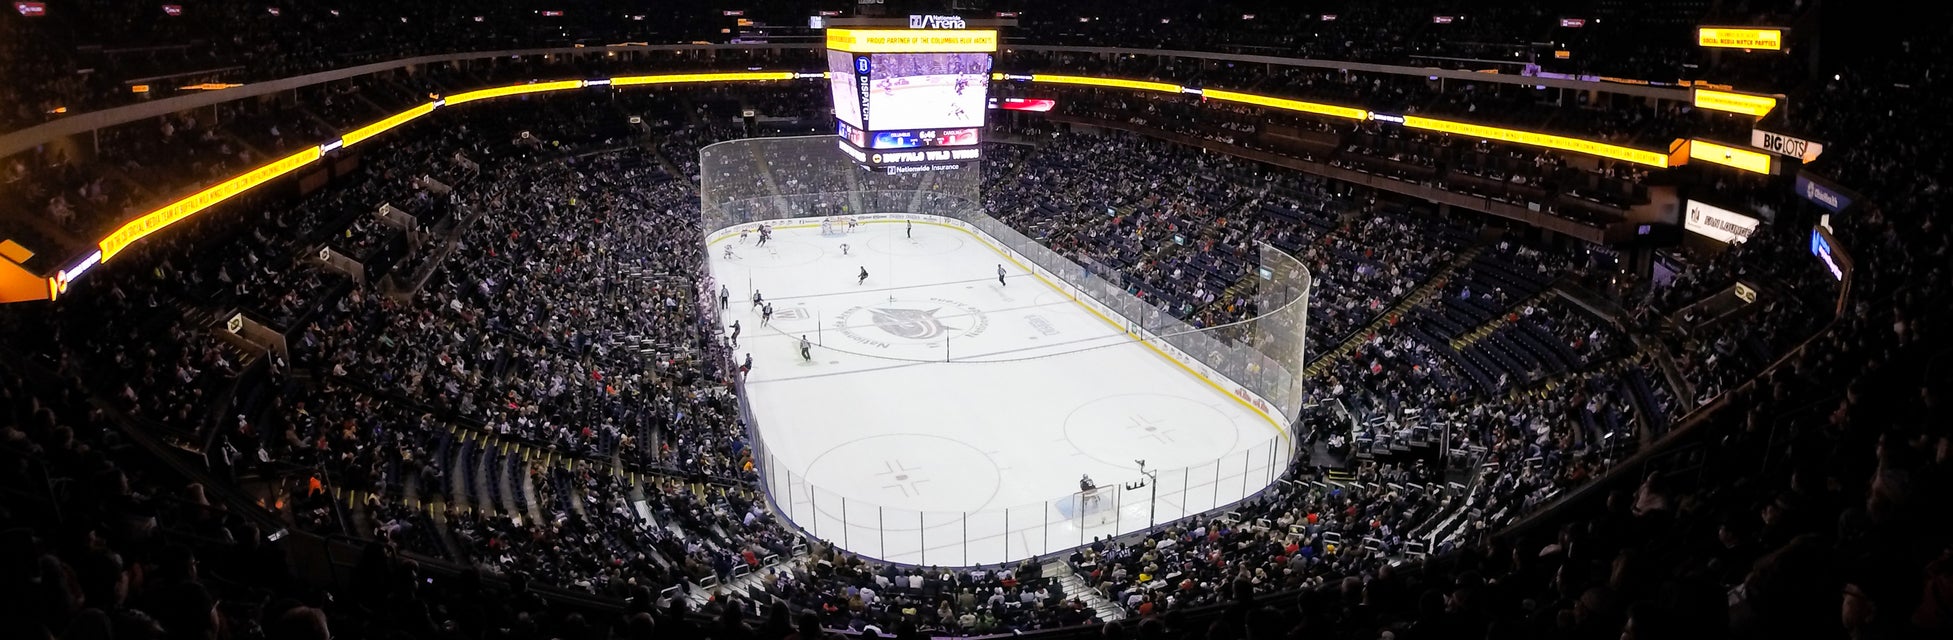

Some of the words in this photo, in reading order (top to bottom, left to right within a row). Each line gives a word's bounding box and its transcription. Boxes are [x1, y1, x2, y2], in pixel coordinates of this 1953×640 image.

[920, 14, 966, 29] Arena
[860, 76, 869, 121] DISPATCH
[882, 152, 925, 163] BUFFALO
[926, 151, 950, 162] WILD
[951, 149, 979, 160] WINGS
[896, 165, 930, 173] Nationwide
[932, 163, 959, 171] Insurance
[145, 215, 160, 229] MEDIA
[161, 208, 173, 222] TEAM
[180, 197, 199, 214] BUFFALO
[1704, 215, 1721, 229] FAN
